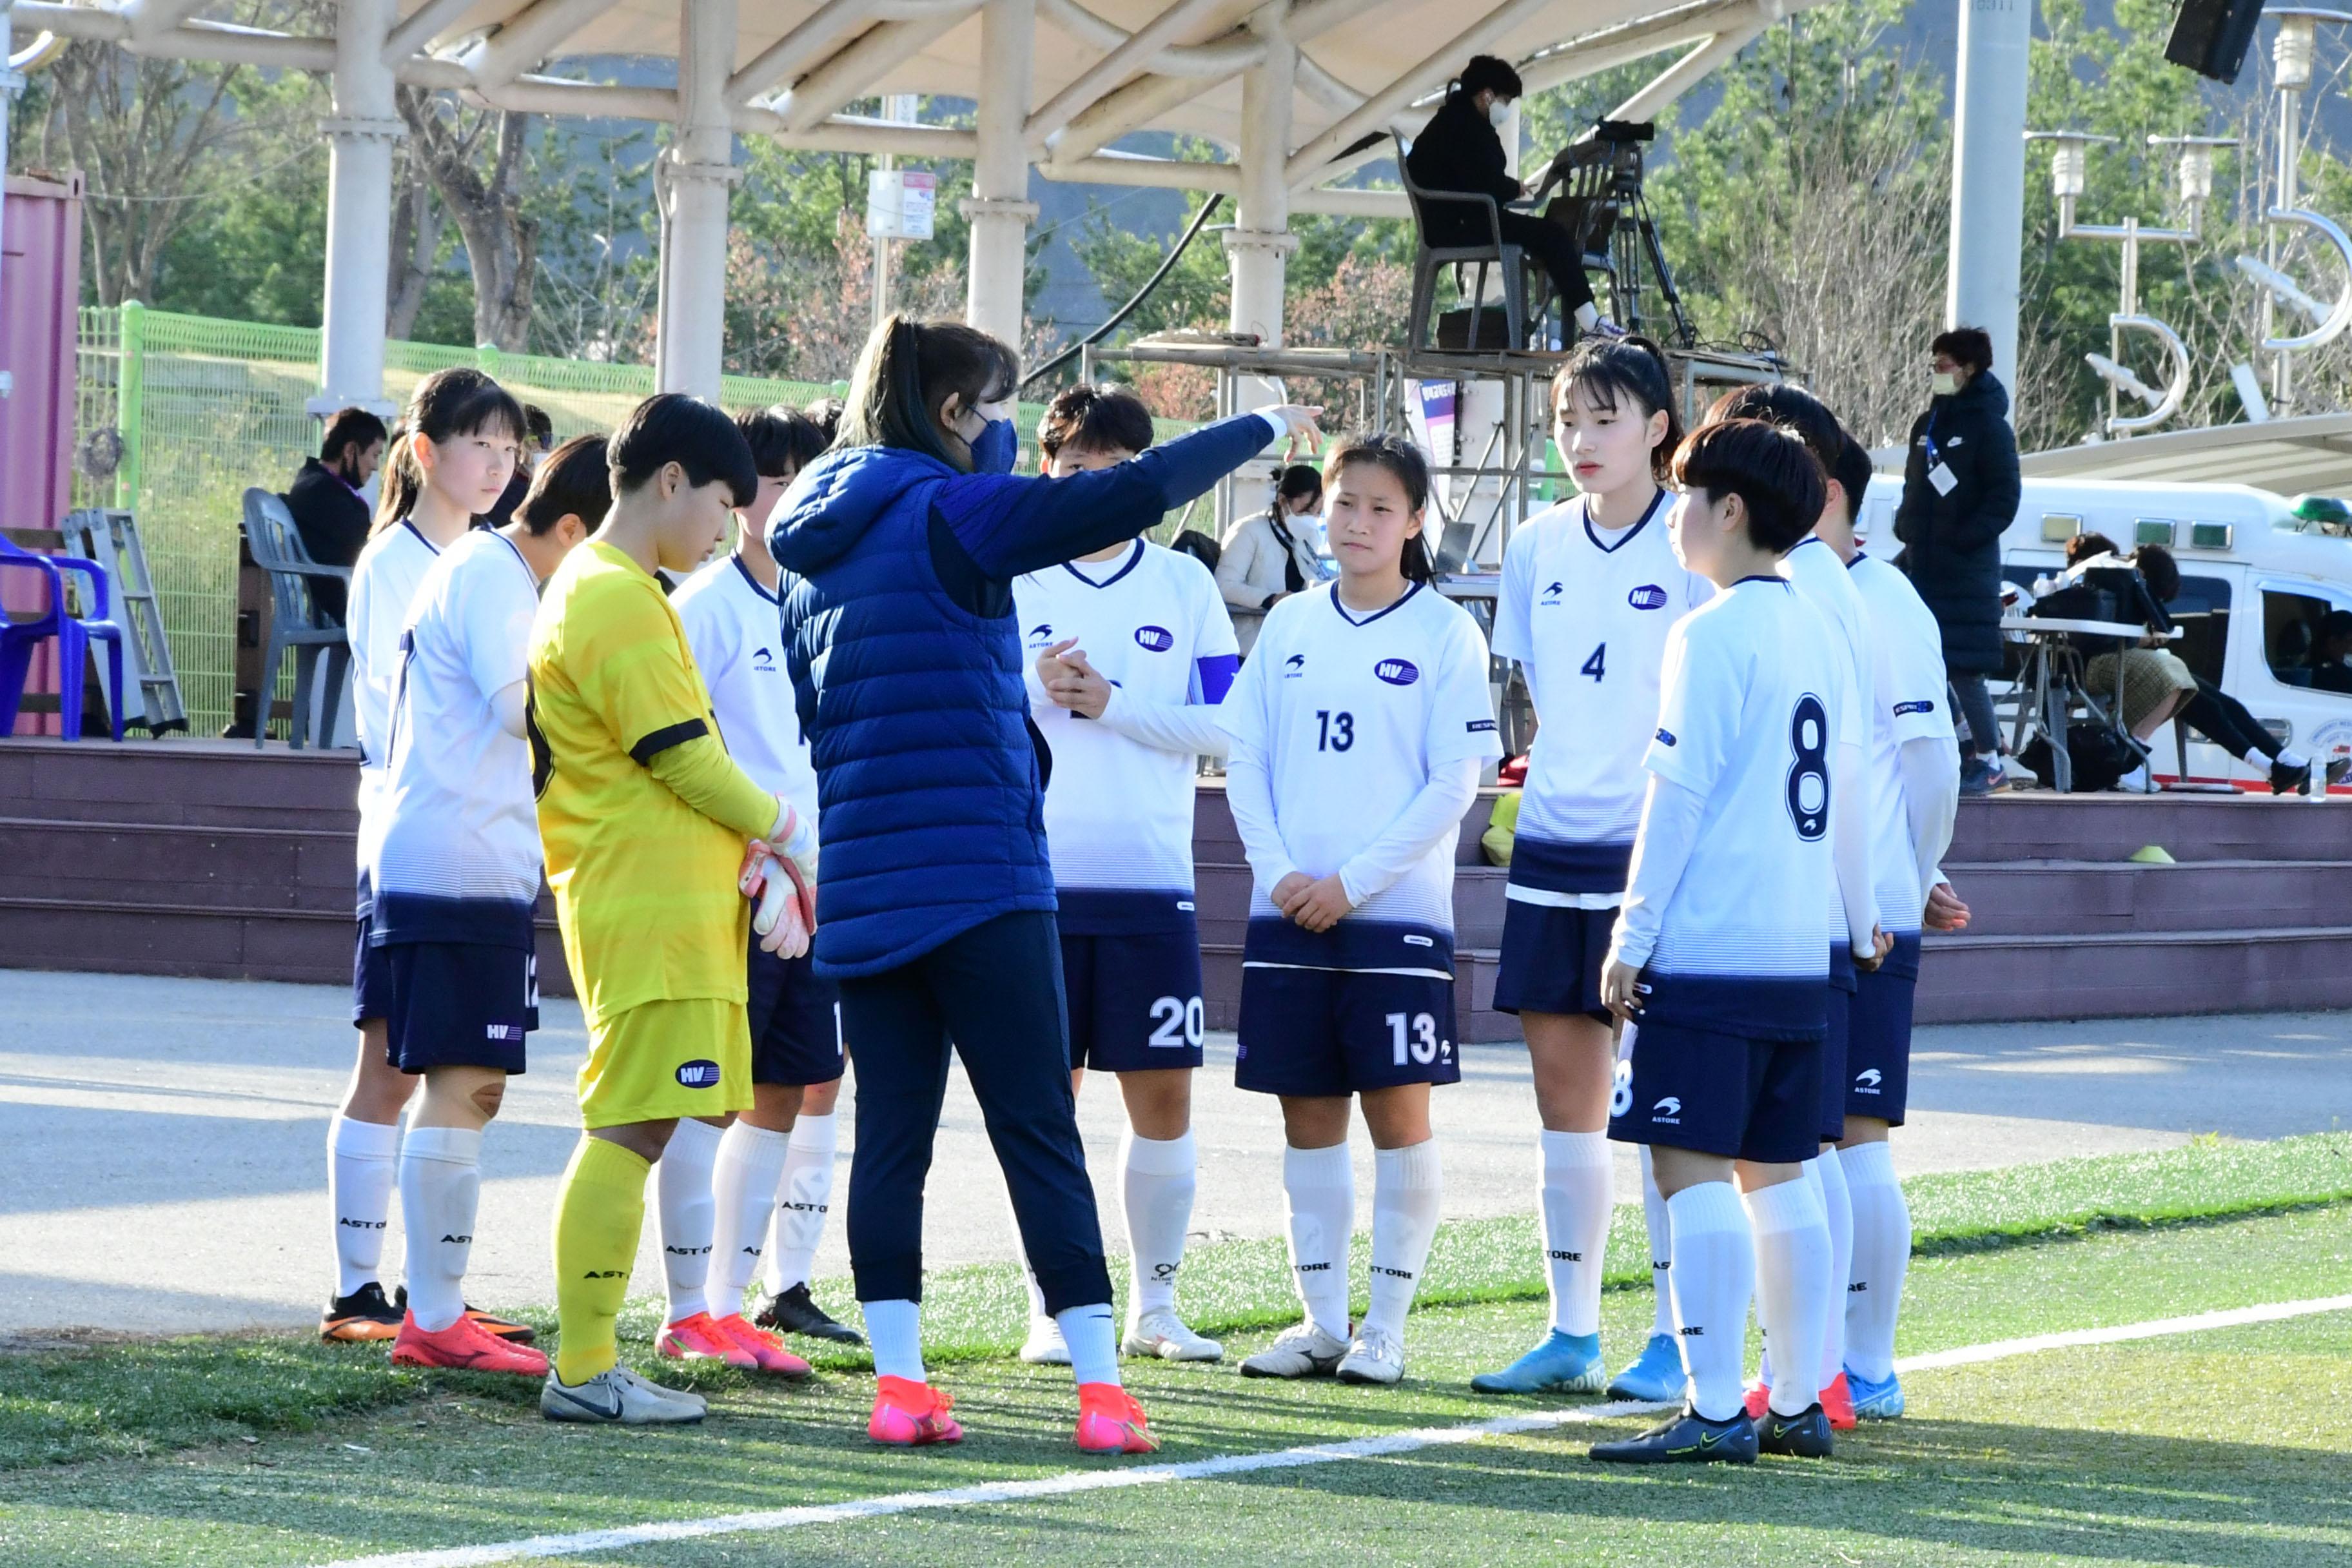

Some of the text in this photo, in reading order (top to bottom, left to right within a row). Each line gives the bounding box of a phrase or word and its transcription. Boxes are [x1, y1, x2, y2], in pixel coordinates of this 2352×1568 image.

[1631, 589, 1651, 605] HV
[1139, 630, 1161, 645] HV
[1378, 662, 1404, 679] HV
[1580, 642, 1606, 683] 4
[1315, 709, 1354, 752] 13
[1785, 692, 1831, 842] 8
[1148, 995, 1204, 1048] 20
[487, 1024, 509, 1040] HV
[1386, 1012, 1437, 1066] 13
[680, 1066, 705, 1083] HV
[1611, 1059, 1633, 1117] 8
[1854, 1086, 1881, 1095] ASTORE
[1652, 1116, 1681, 1125] ASTORE
[782, 1201, 828, 1213] ASTO
[340, 1217, 387, 1229] ASTO
[666, 1245, 713, 1255] ASTO
[583, 1270, 631, 1280] AST
